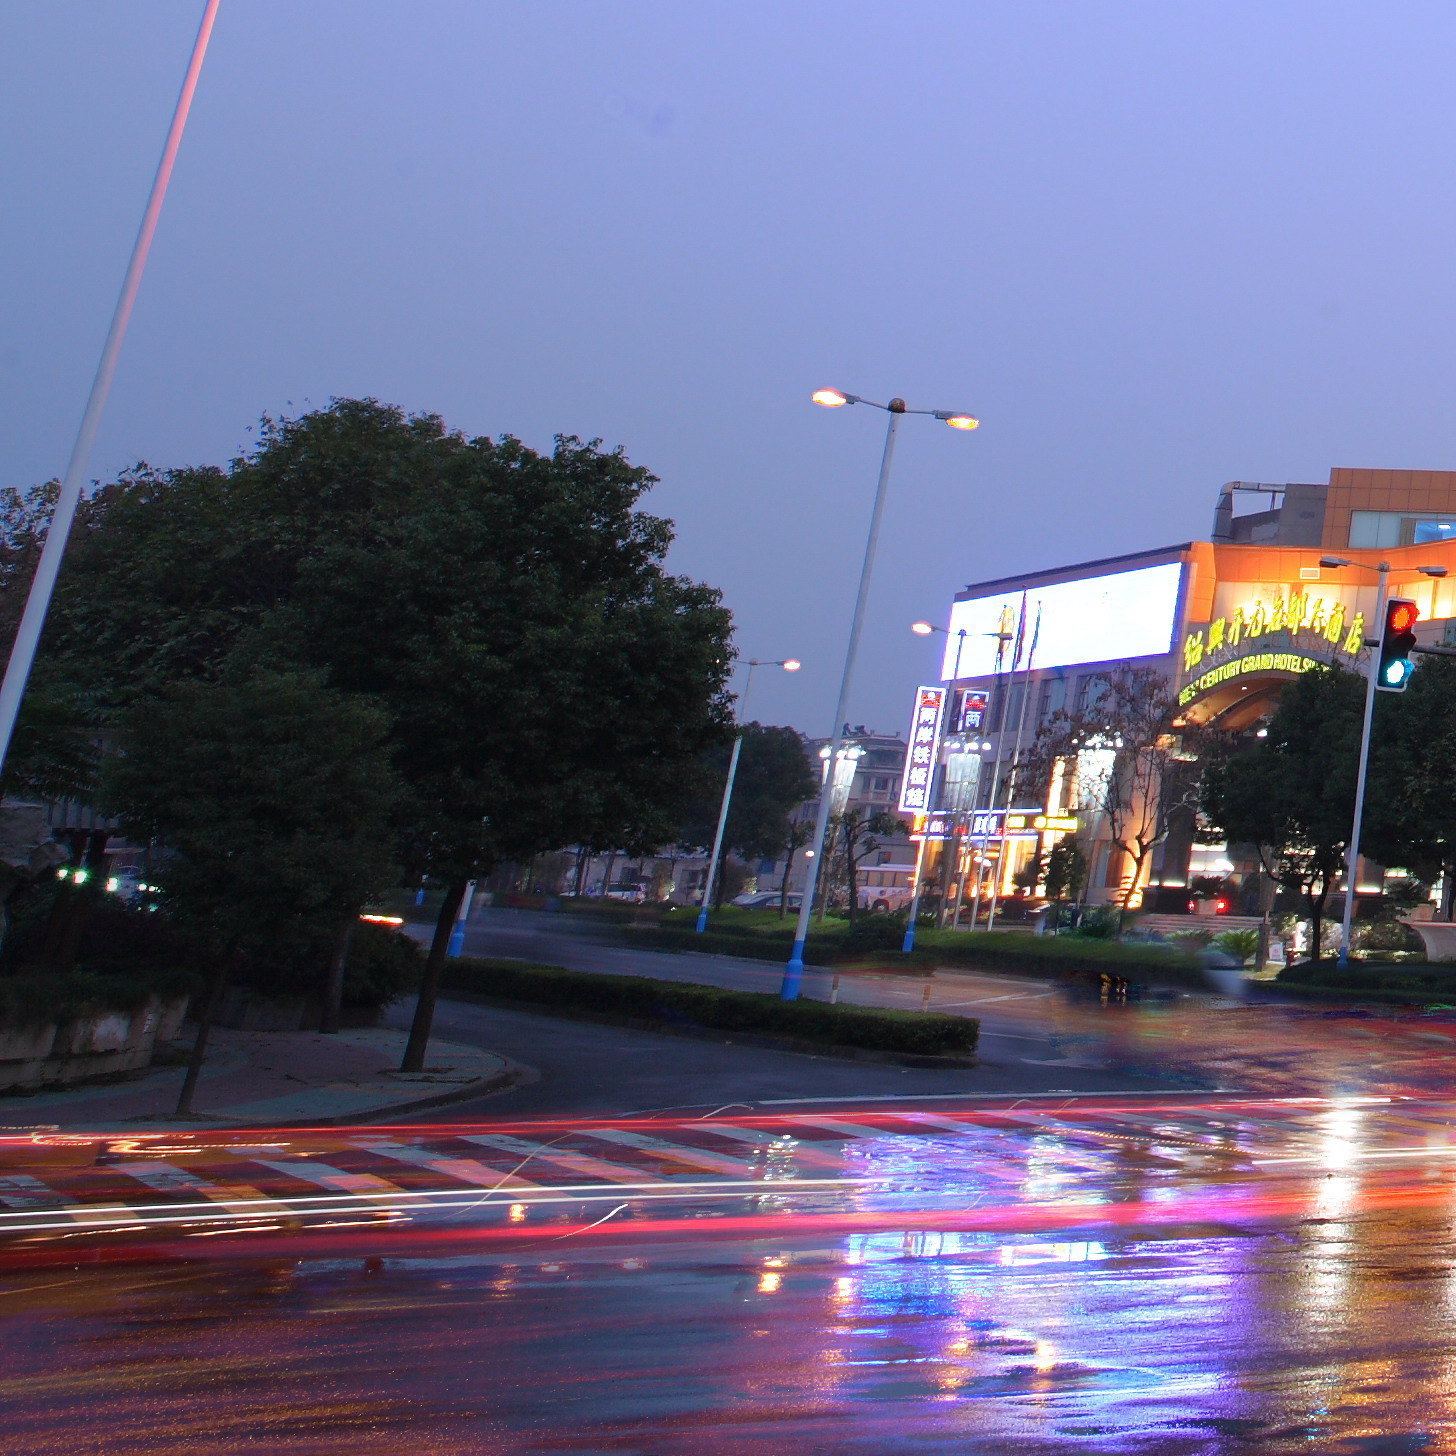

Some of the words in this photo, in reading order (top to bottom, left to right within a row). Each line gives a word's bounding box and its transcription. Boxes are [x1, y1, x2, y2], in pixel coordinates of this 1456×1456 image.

[1200, 659, 1242, 691] CENTURY
[1241, 653, 1274, 674] GRAND
[1274, 653, 1303, 674] HOTEL
